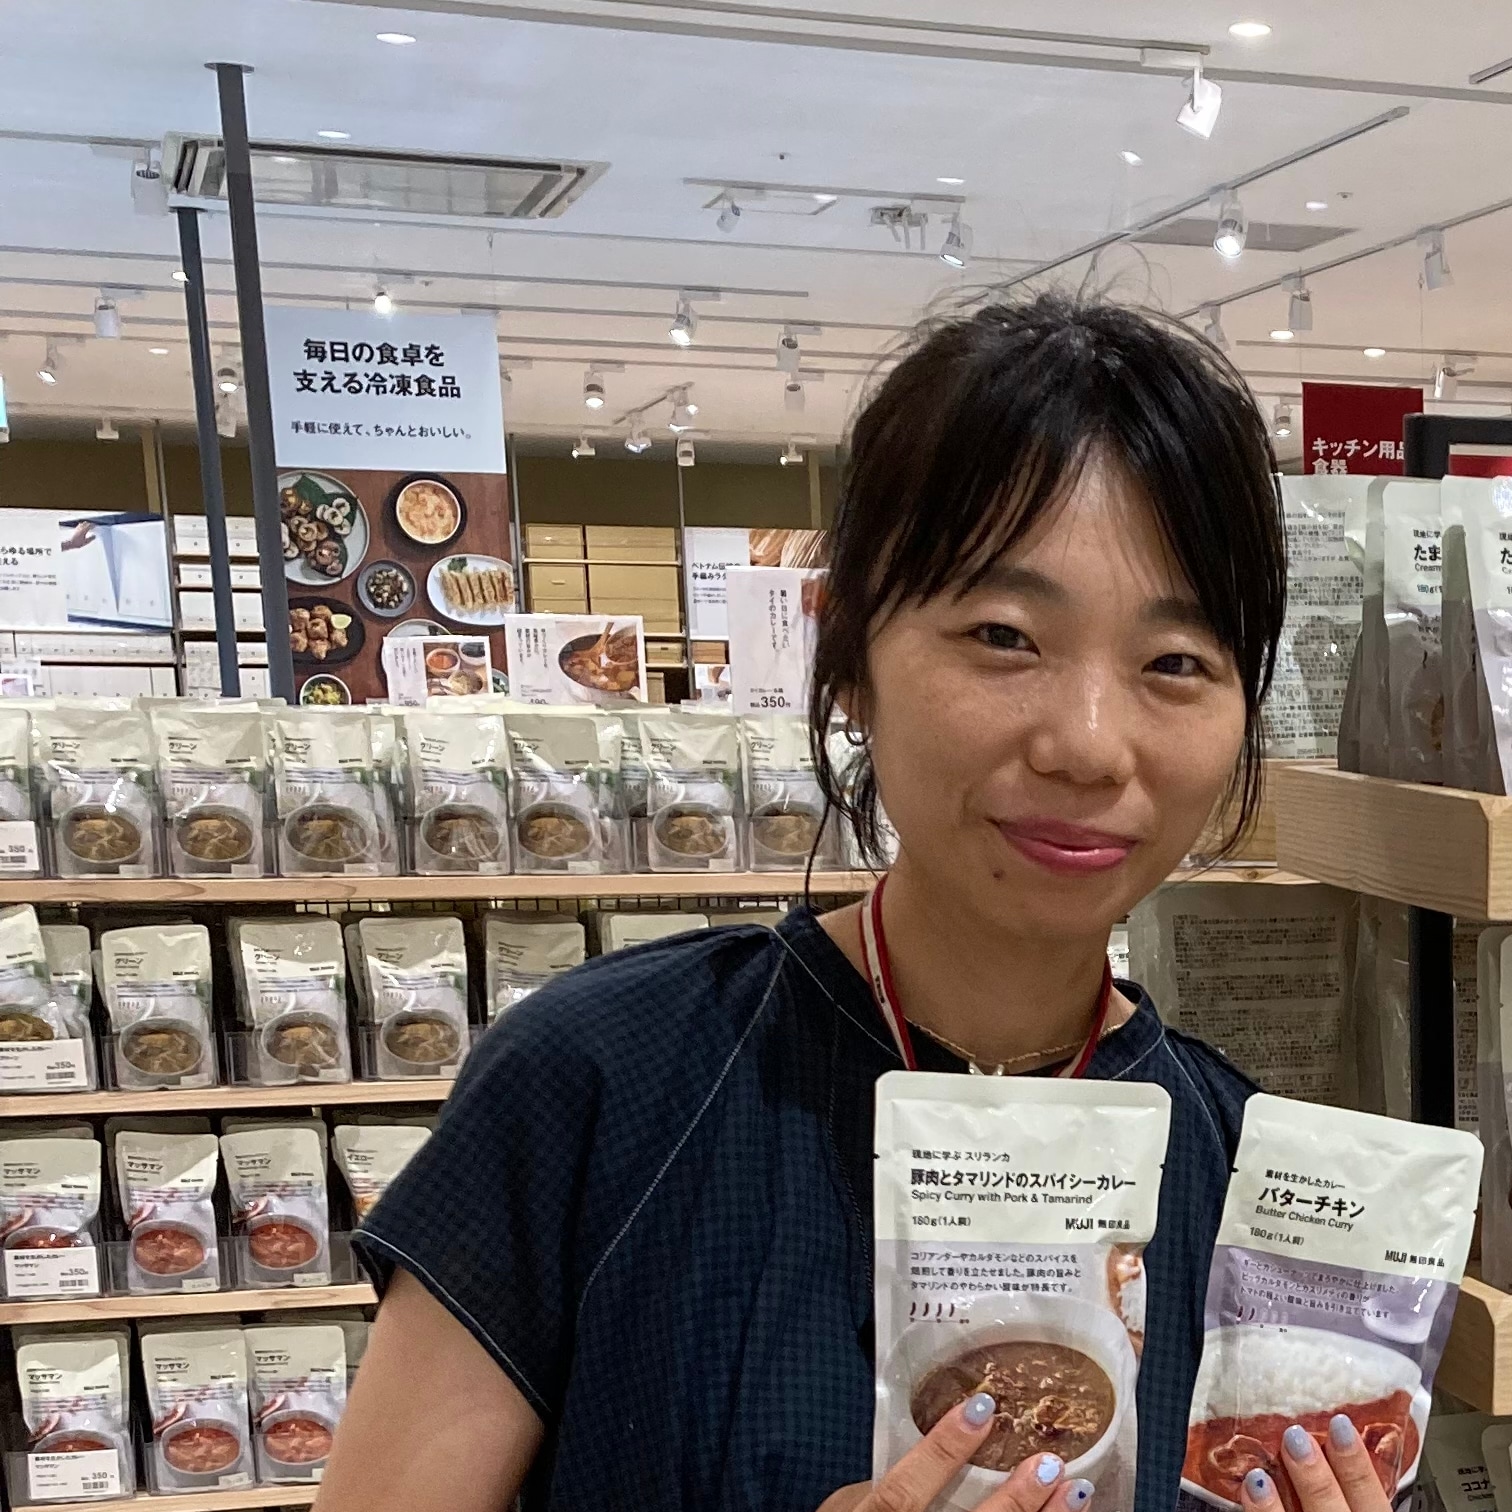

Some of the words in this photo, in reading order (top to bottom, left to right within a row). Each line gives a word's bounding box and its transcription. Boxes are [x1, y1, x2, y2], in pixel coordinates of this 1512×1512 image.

[303, 339, 445, 367] 毎日の食卓を
[293, 369, 461, 398] 支える冷凍食品
[291, 421, 472, 440] 手軽に使えて、ちゃんとおいしい。
[1312, 458, 1348, 475] 食器
[913, 1150, 961, 1160] 現地に学ぶ
[965, 1151, 1010, 1162] スリランカ
[911, 1169, 1136, 1190] 豚肉とタマリンドのスパイシーカレー
[1265, 1169, 1345, 1189] 素材を生かしたカレー
[912, 1190, 941, 1201] Spicy
[944, 1191, 975, 1203] Curry
[978, 1192, 1000, 1202] with
[1004, 1193, 1027, 1203] Pork
[1031, 1193, 1038, 1203] &
[1042, 1194, 1092, 1204] Tamarind
[1259, 1187, 1365, 1218] バターチキン
[1066, 1218, 1093, 1230] MUJI
[1256, 1205, 1286, 1219] Butter
[1288, 1212, 1326, 1225] Chicken
[1328, 1218, 1354, 1232] Curry
[1385, 1250, 1406, 1263] MUJI
